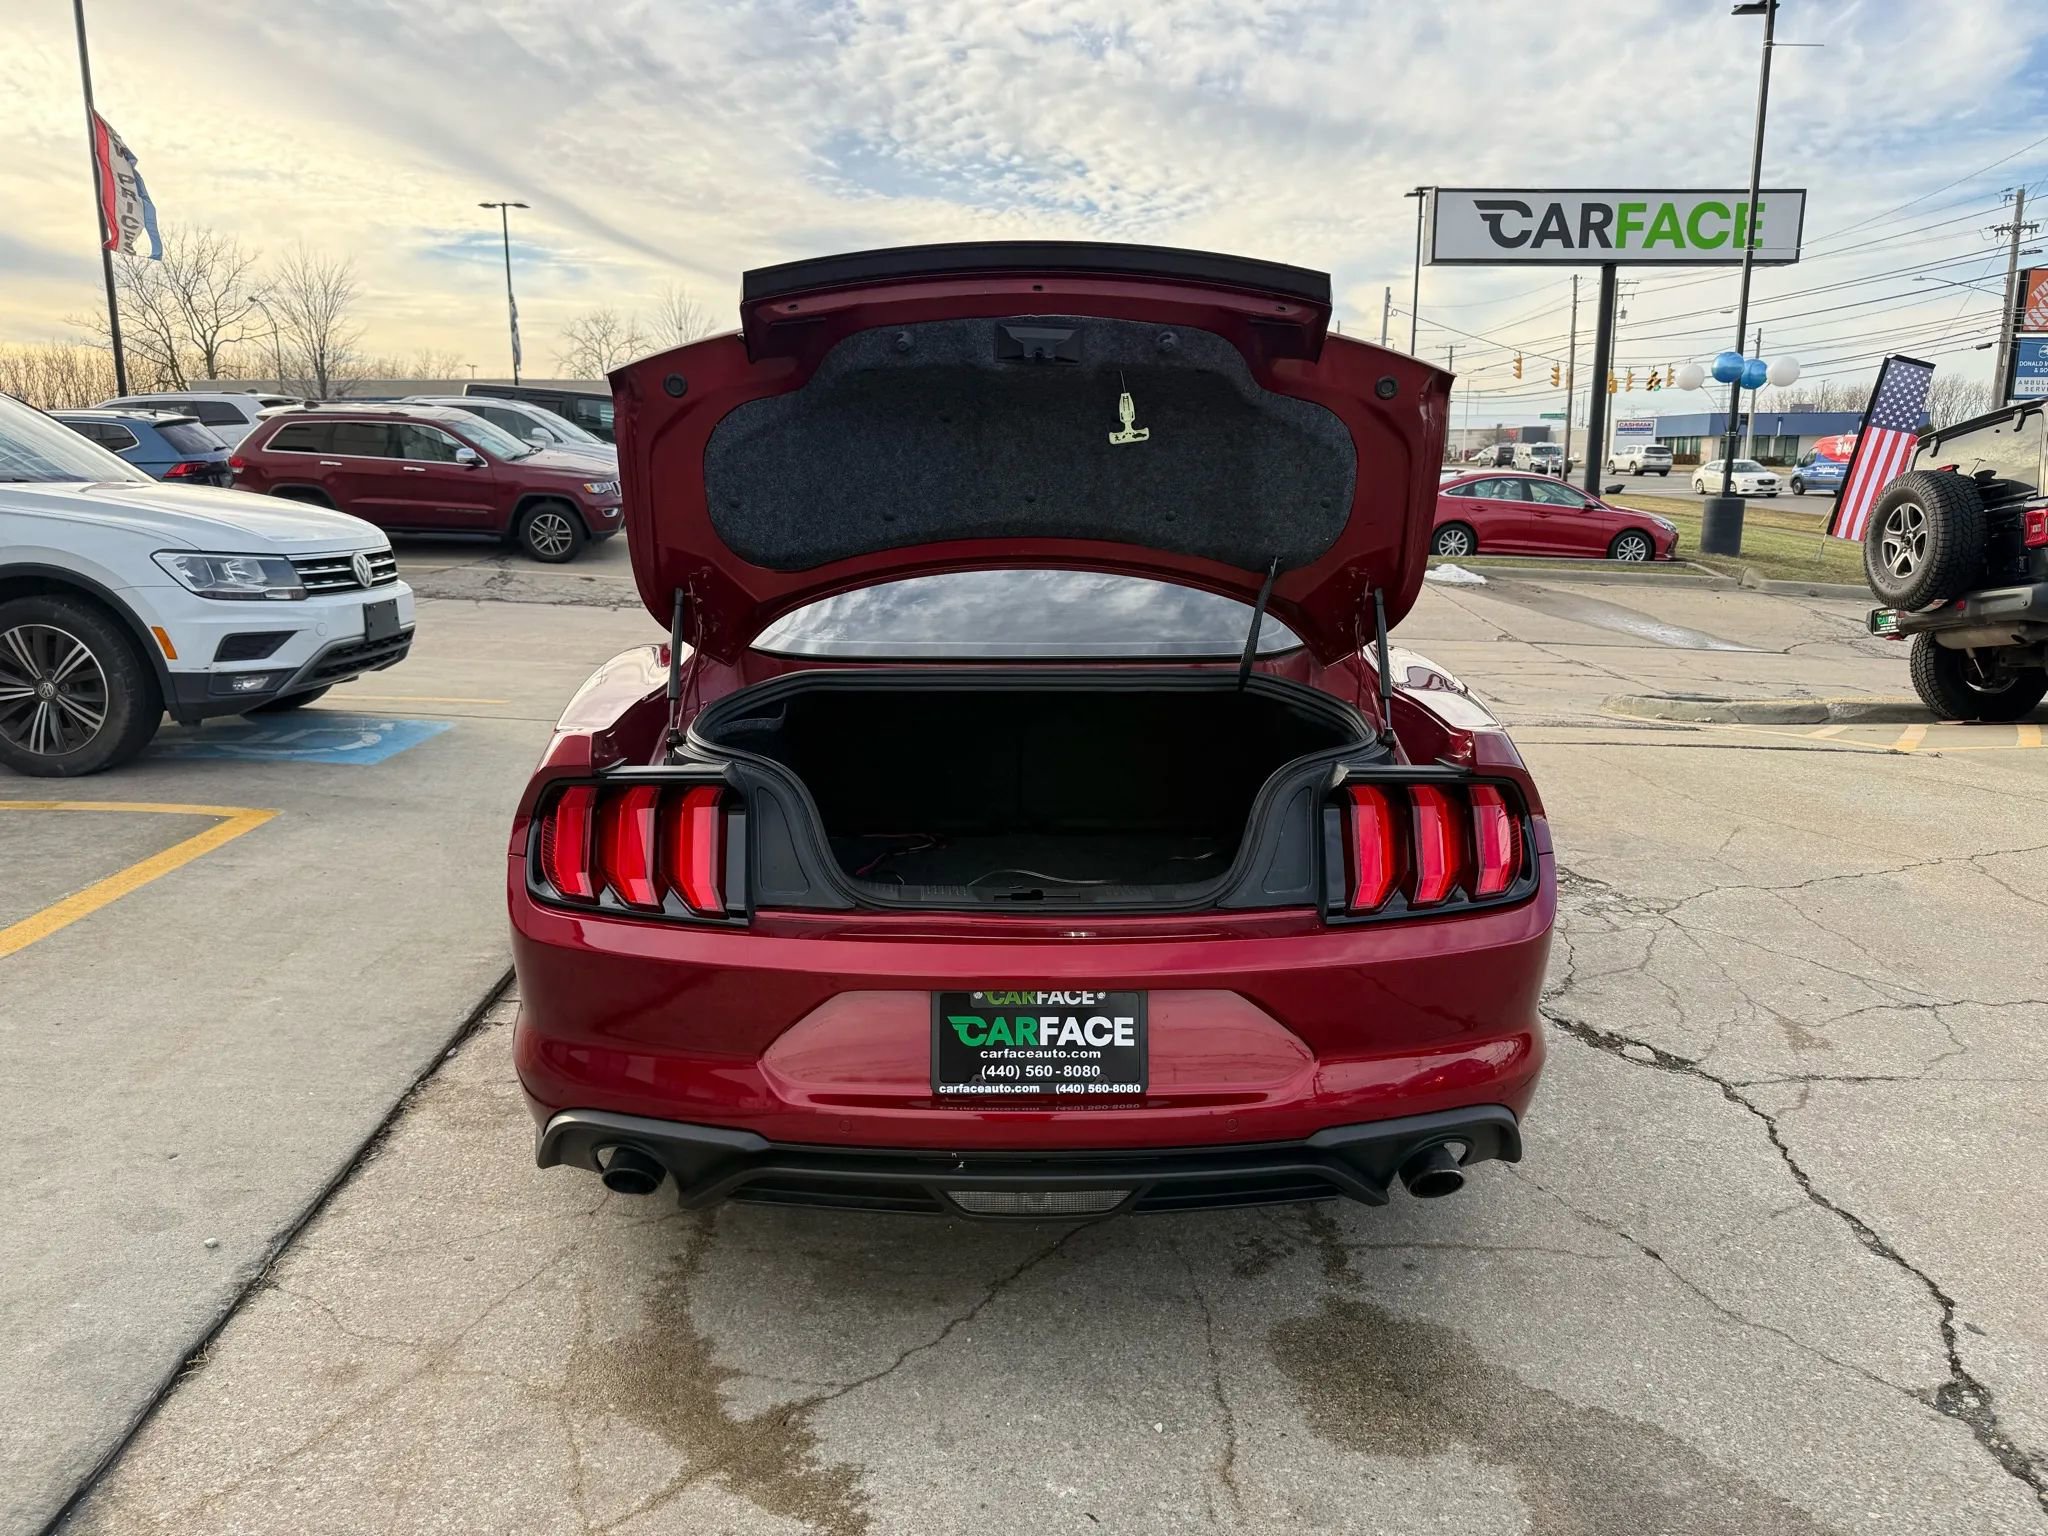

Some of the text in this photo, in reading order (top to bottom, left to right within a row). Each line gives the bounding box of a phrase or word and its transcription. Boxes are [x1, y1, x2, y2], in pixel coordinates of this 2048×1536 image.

[1472, 200, 1765, 249] CARFACE
[983, 991, 1095, 1005] CARFACE
[947, 1016, 1135, 1047] CARFACE
[980, 1049, 1101, 1059] carfaceauto.com
[981, 1065, 1020, 1080] (440)
[939, 1084, 1141, 1094] carfaceauto.com (440) 560-8080
